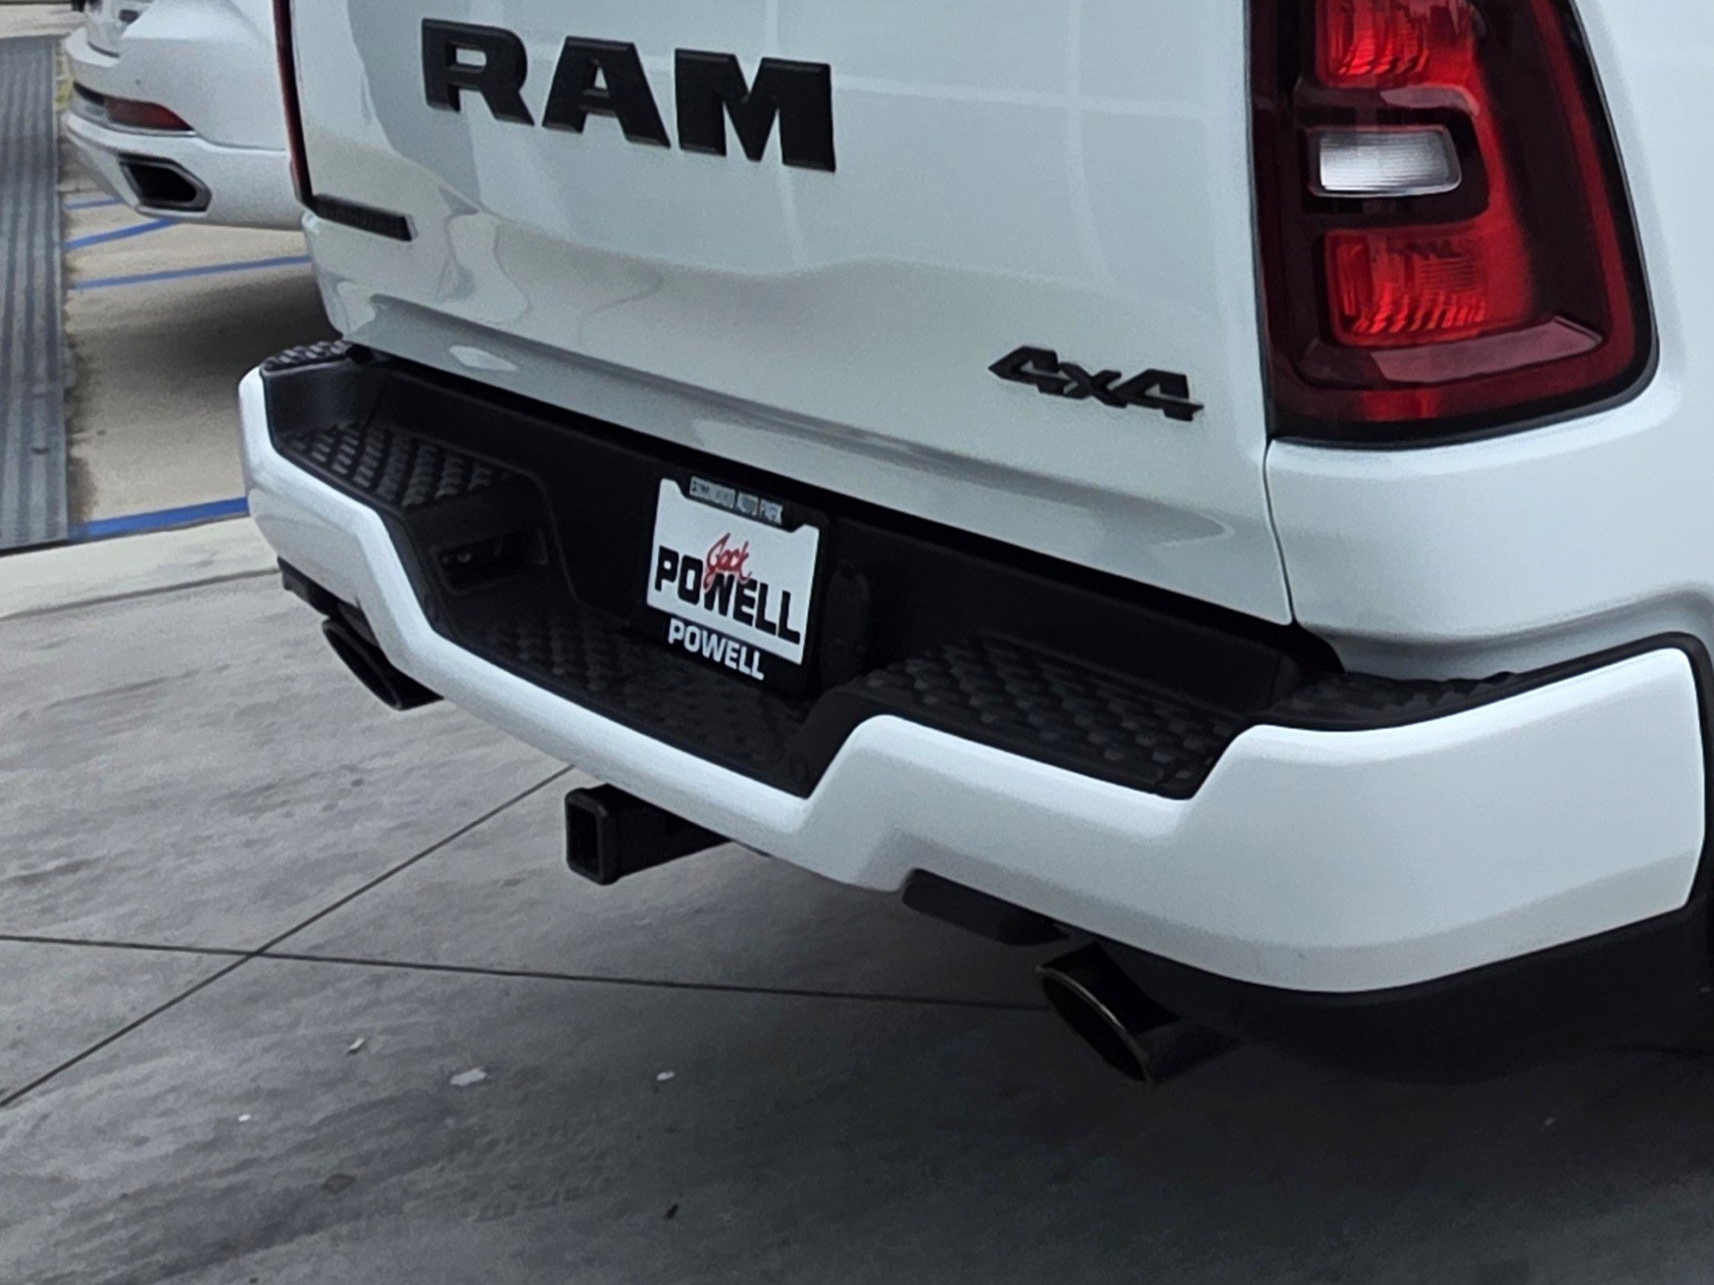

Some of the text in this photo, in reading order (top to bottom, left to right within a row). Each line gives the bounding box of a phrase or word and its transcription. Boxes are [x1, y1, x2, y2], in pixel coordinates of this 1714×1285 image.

[421, 17, 837, 173] RAM
[654, 545, 801, 646] POWELL
[703, 532, 752, 591] Jack
[667, 617, 765, 681] POWELL
